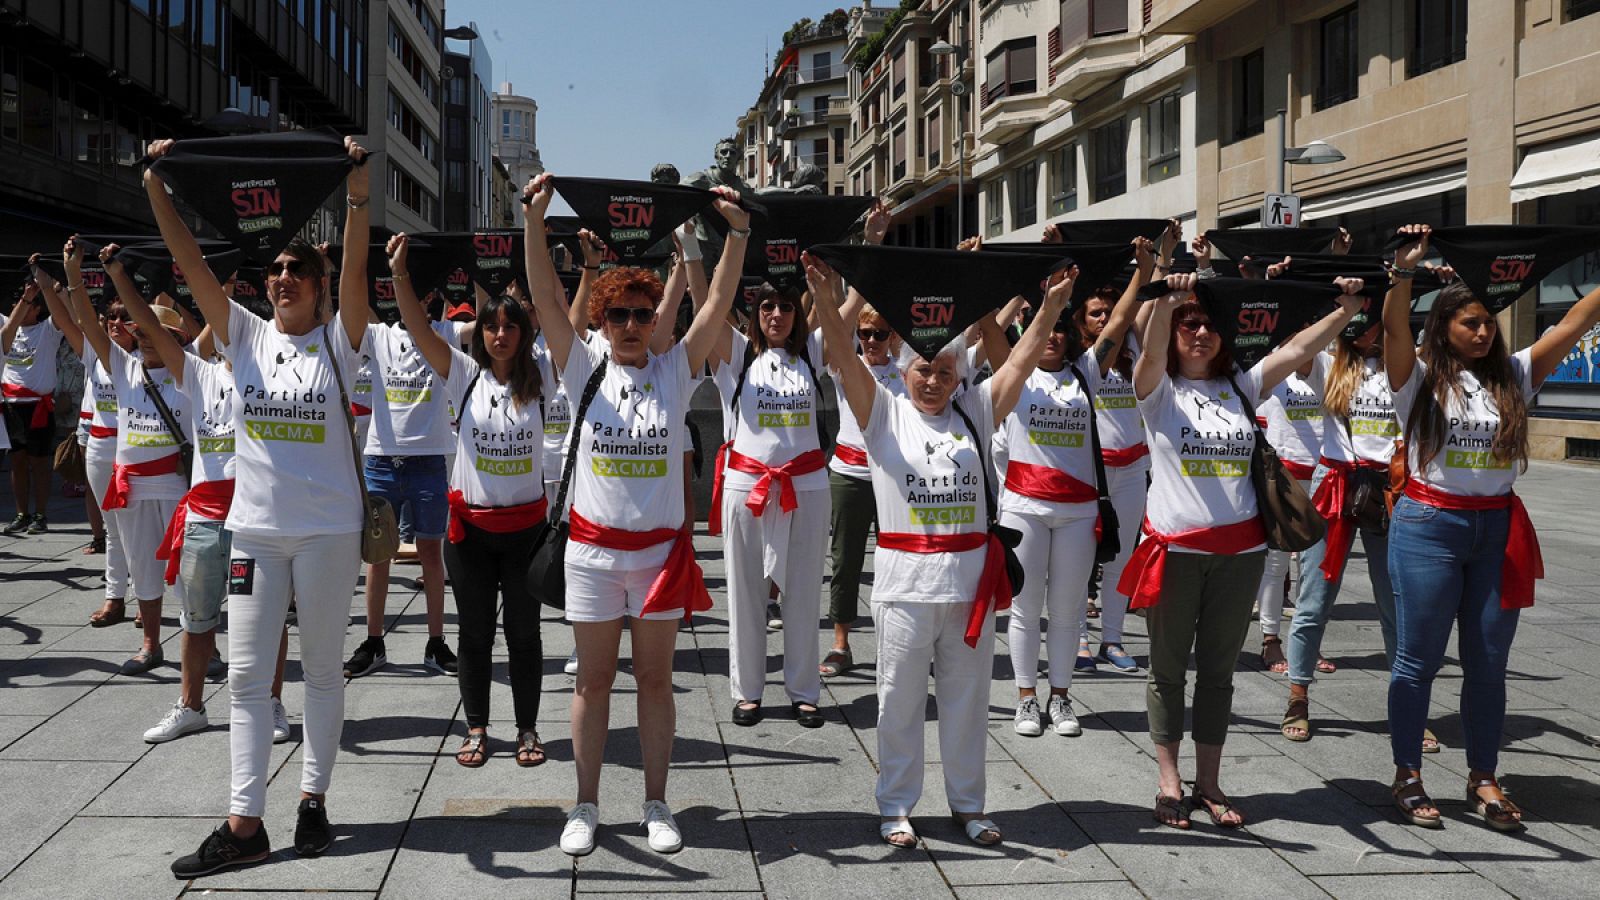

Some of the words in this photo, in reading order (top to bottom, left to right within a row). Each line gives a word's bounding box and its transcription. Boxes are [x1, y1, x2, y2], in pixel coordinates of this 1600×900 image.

[231, 187, 281, 217] SIN
[608, 202, 655, 228] SIN
[472, 235, 513, 257] SIN
[765, 244, 799, 264] SIN
[1489, 258, 1536, 283] SIN
[374, 281, 395, 300] SI
[910, 303, 956, 327] SIN
[1238, 308, 1281, 334] SIN
[244, 384, 326, 404] Partido
[756, 387, 812, 398] Partido
[243, 402, 327, 421] Animalista
[757, 400, 811, 411] Animalista
[1029, 403, 1088, 419] Partido
[763, 415, 807, 426] PACMA
[1028, 417, 1087, 431] Animalista
[1449, 417, 1499, 432] Parti
[253, 423, 315, 441] PACMA
[472, 427, 533, 442] Partido
[592, 422, 669, 438] Partido
[1180, 426, 1253, 441] Partido
[1035, 432, 1078, 445] PACMA
[475, 443, 533, 457] Animalista
[591, 440, 668, 456] Animalista
[1180, 442, 1252, 457] Animalista
[598, 462, 658, 475] PACMA
[1189, 462, 1242, 475] PACMA
[906, 471, 978, 487] Partido
[906, 489, 977, 504] Animalista
[916, 509, 971, 522] PACMA
